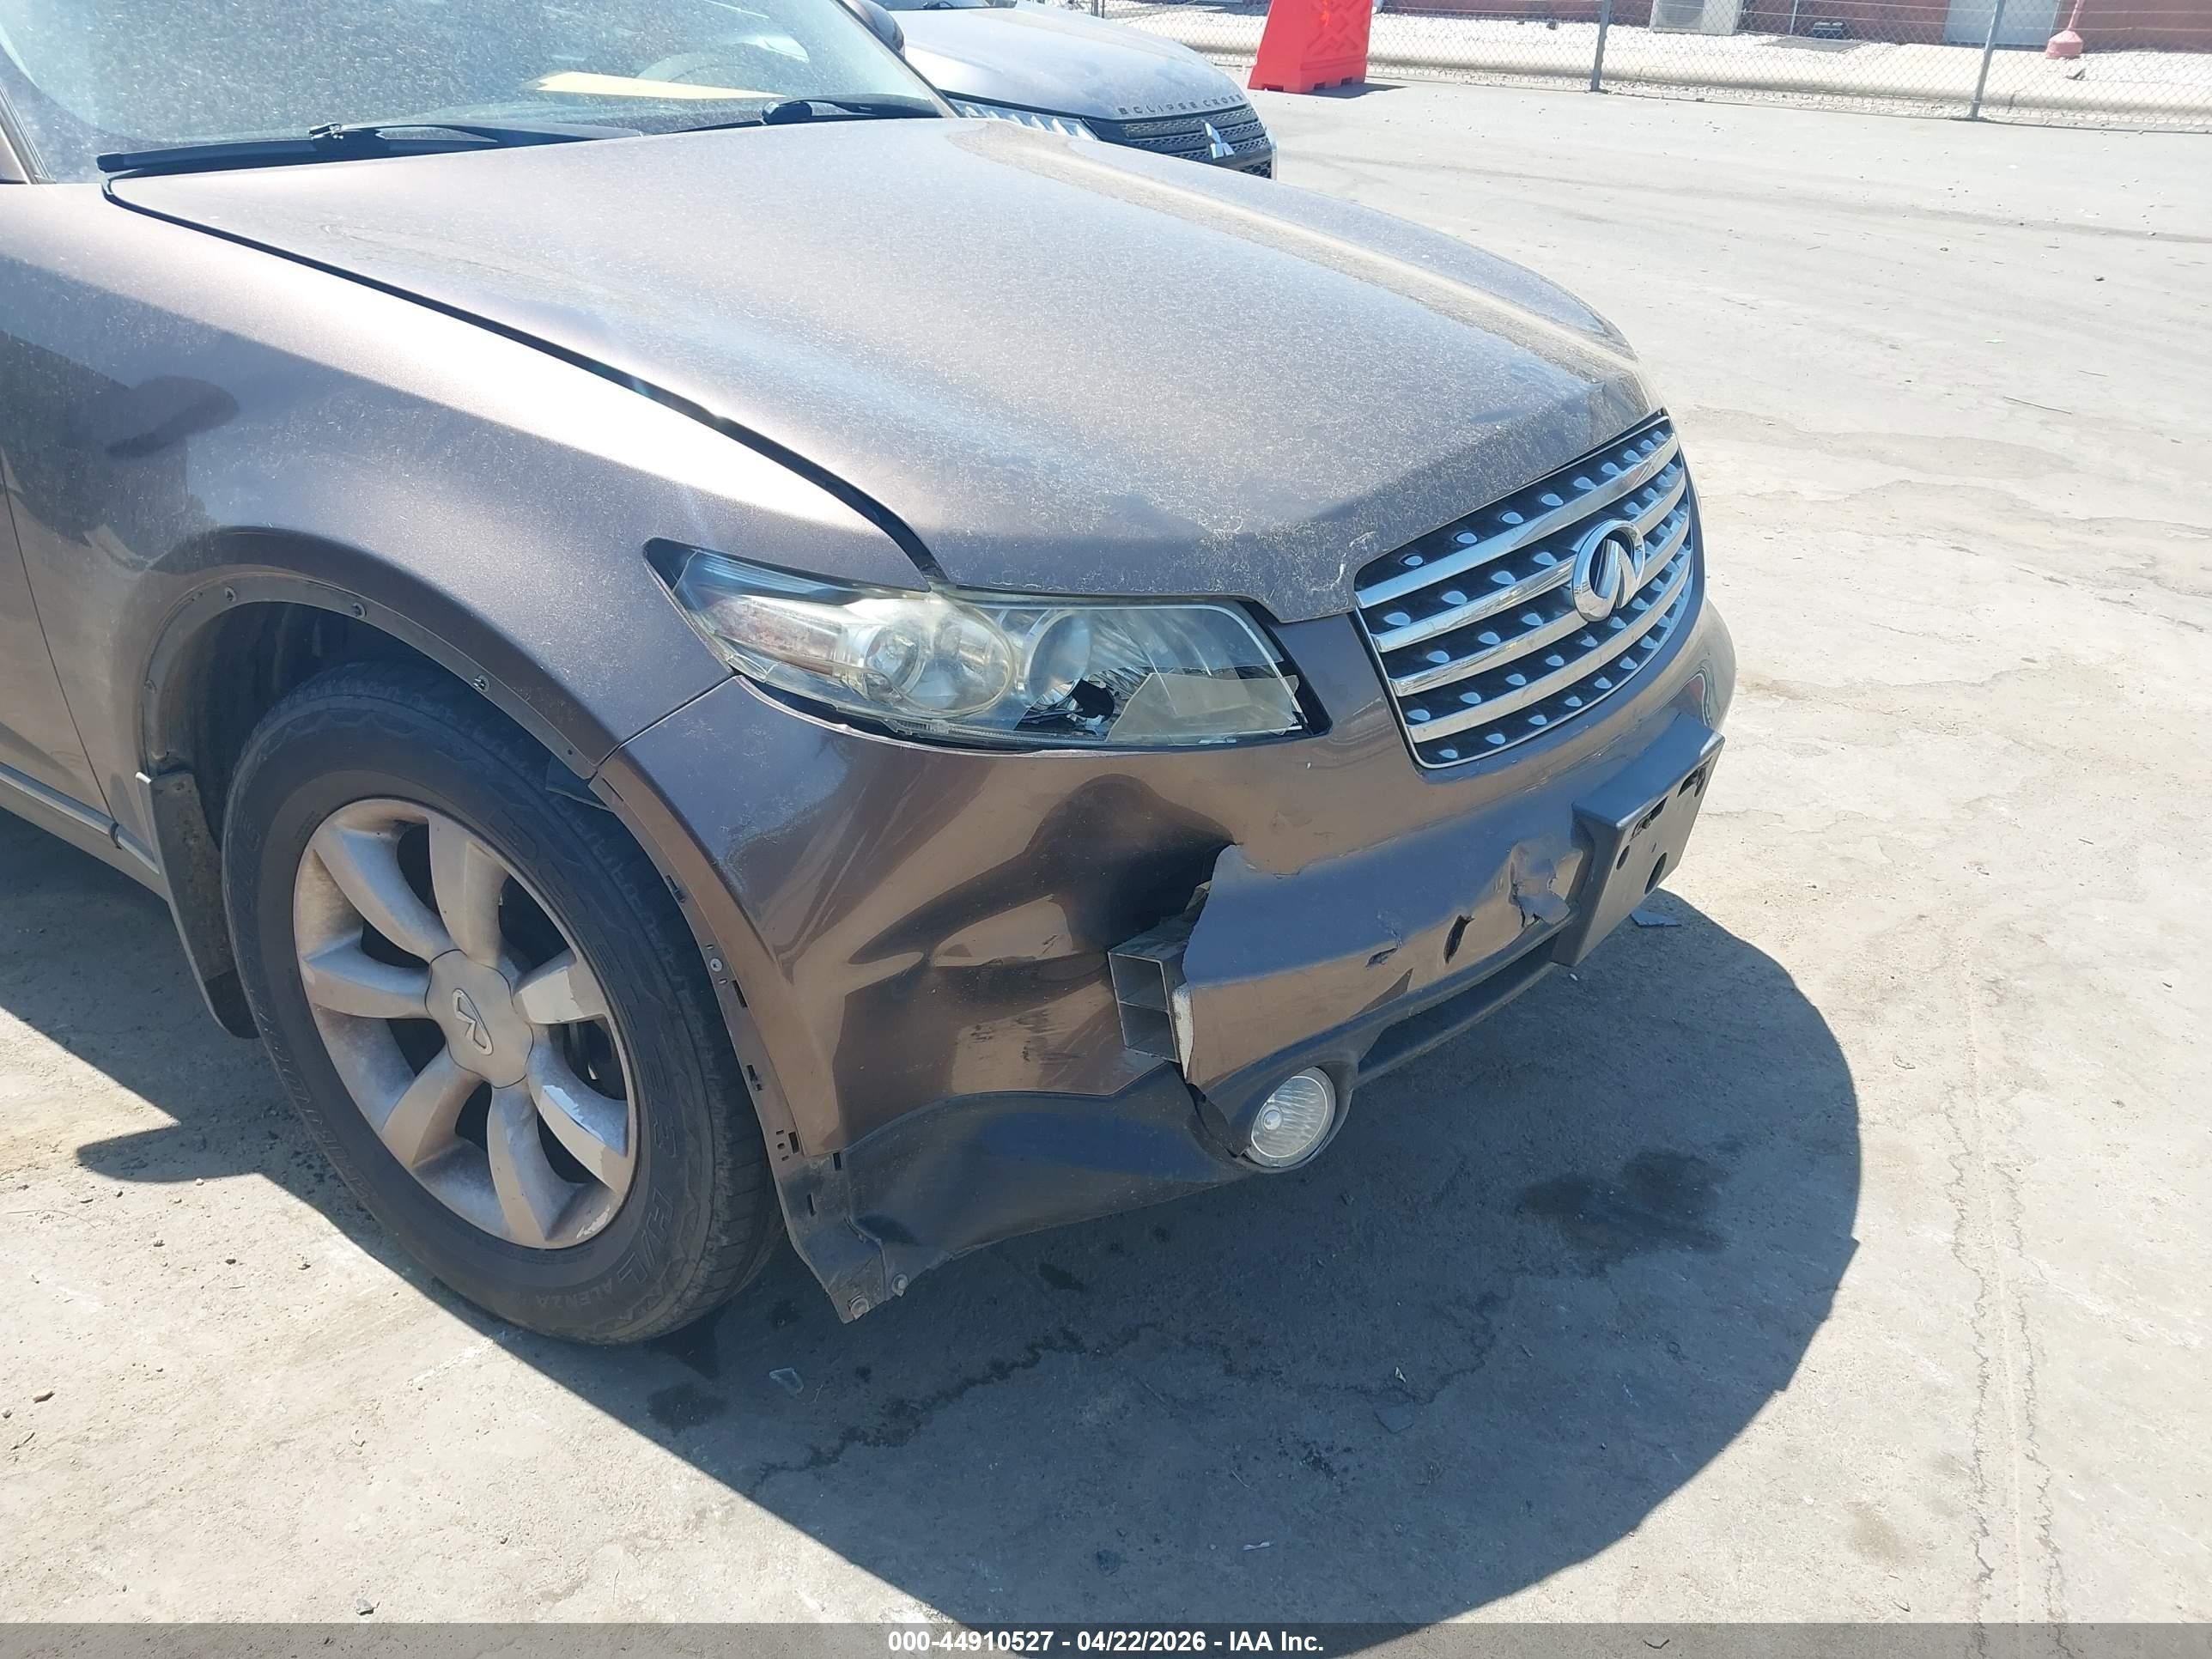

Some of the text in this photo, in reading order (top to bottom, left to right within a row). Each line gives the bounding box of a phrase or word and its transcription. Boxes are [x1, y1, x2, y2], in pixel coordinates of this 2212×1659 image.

[1117, 93, 1243, 116] ECLIPSE CROSS
[535, 1277, 613, 1309] ALENZA
